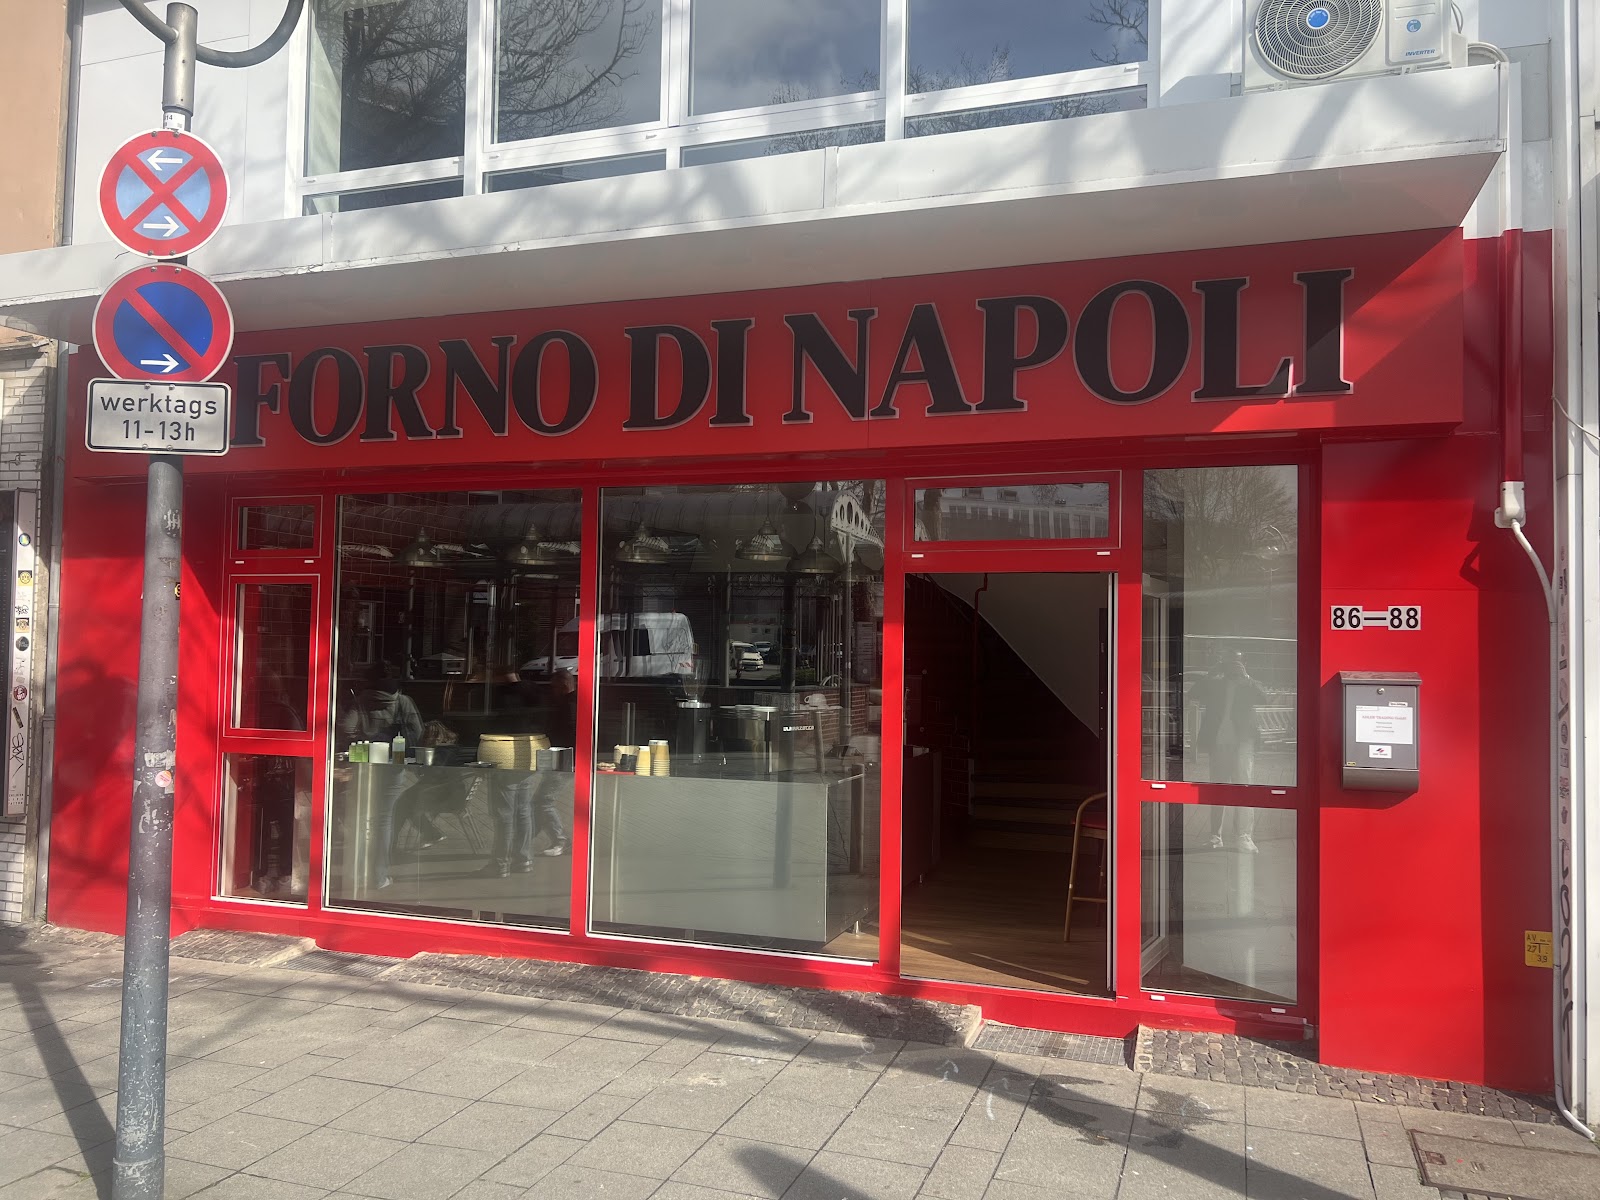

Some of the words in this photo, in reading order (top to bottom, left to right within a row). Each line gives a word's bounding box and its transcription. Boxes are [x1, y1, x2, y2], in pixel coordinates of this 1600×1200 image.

[229, 329, 599, 448] FORNO
[622, 317, 756, 432] DI
[781, 266, 1355, 424] NAPOLI
[100, 393, 217, 419] werktags
[122, 419, 195, 441] 11-13h
